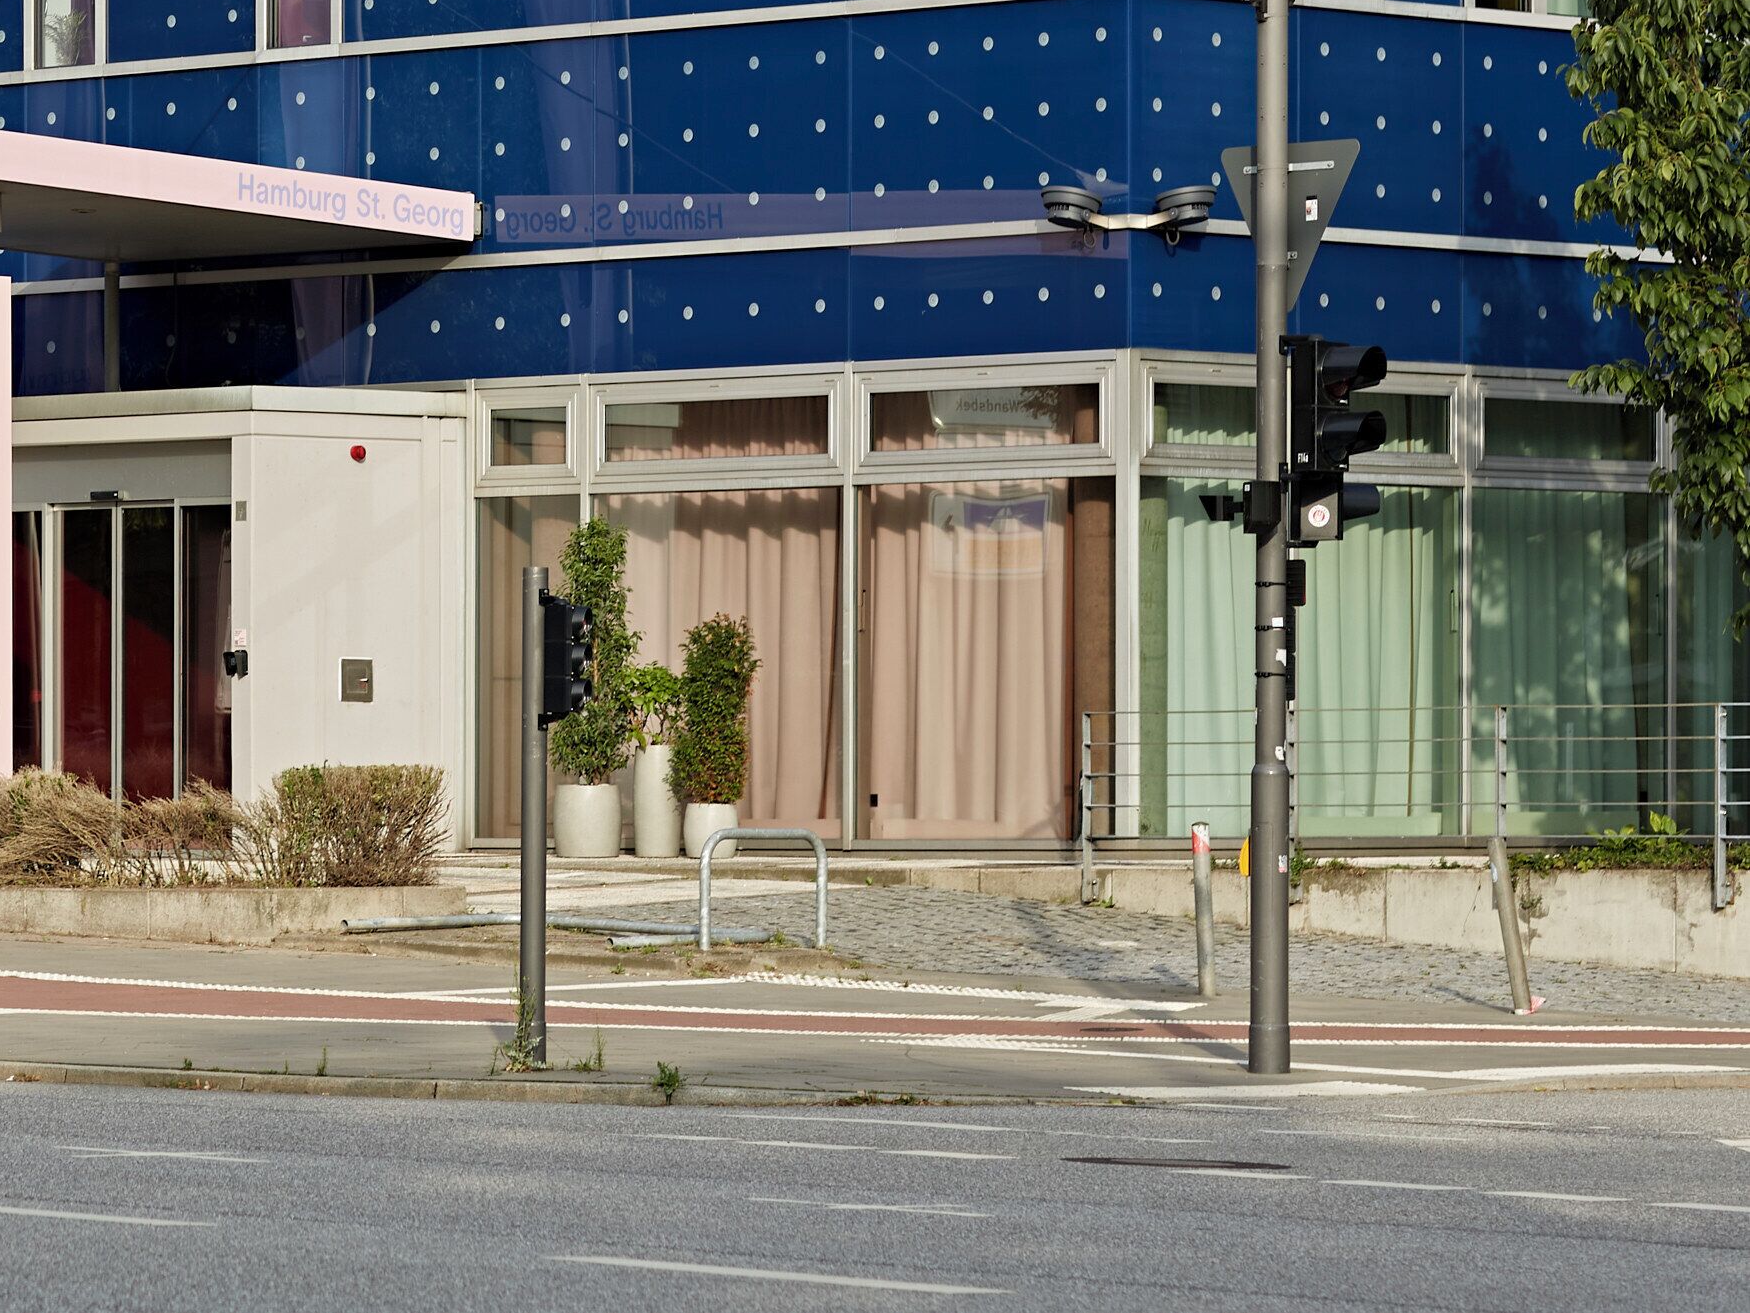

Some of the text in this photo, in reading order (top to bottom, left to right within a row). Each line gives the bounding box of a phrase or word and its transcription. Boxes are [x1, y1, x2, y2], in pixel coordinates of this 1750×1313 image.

[238, 172, 465, 237] Hamburg St. Georg
